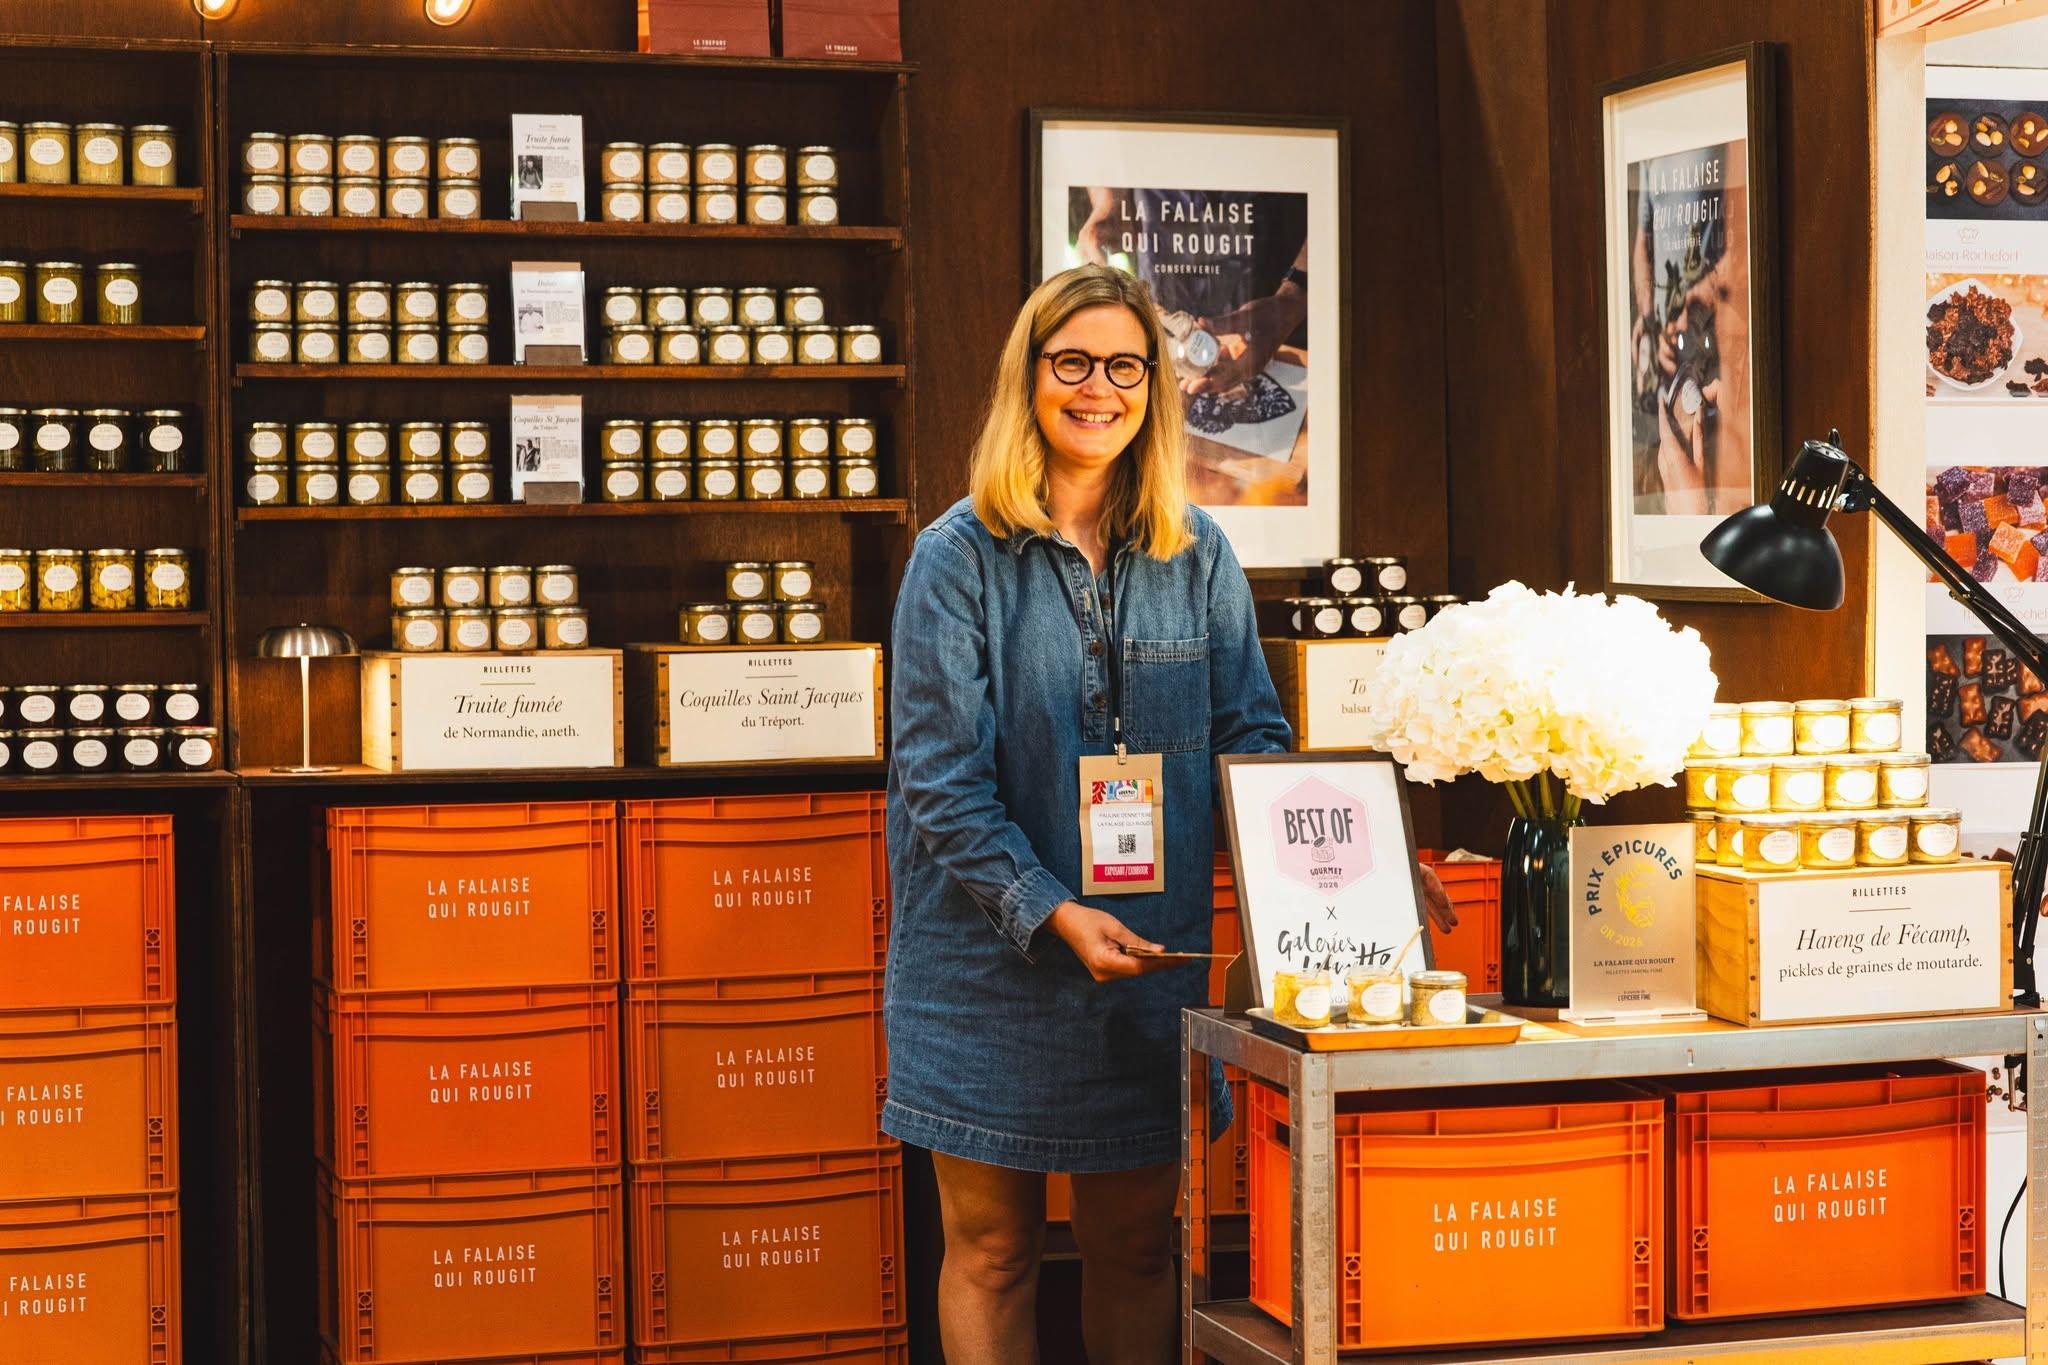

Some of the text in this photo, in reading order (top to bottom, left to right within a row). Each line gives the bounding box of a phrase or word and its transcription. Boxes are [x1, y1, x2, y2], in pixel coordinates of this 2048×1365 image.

[1653, 159, 1720, 196] LA FALAISE
[1121, 200, 1254, 224] LA FALAISE
[1652, 196, 1719, 231] QUI ROUGIT
[1121, 231, 1254, 256] QUI ROUGIT
[1154, 263, 1221, 275] CONSERVERIE
[483, 665, 532, 674] RILLETTES
[748, 658, 793, 667] RILLETTES
[454, 694, 563, 719] Truite fumée
[680, 687, 864, 713] Coquilles Saint Jacques
[443, 724, 580, 739] de Normandie, aneth.
[741, 714, 805, 730] du Tréport.
[1283, 808, 1354, 846] BEST OF
[713, 866, 812, 886] LA FALAISE
[1310, 867, 1343, 876] GOURMET
[1586, 839, 1683, 916] PRIX ÉPICURES
[427, 876, 530, 896] LA FALAISE
[1852, 886, 1907, 897] RILLETTES
[3, 893, 80, 912] FALAISE
[428, 899, 530, 919] QUI ROUGIT
[714, 889, 812, 909] QUI ROUGIT
[13, 917, 80, 936] ROUGIT
[1600, 925, 1615, 940] OR
[1277, 921, 1357, 963] Galeries
[1796, 923, 1971, 954] Hareng de Fécamp,
[1604, 959, 1633, 967] FALAISE
[1634, 958, 1648, 966] QUI
[1648, 957, 1675, 965] ROUGIT
[1779, 953, 1983, 983] pickles de graines de moutarde.
[716, 1046, 815, 1066] LA FALAISE
[429, 1060, 532, 1081] LA FALAISE
[717, 1068, 815, 1089] QUI ROUGIT
[6, 1083, 83, 1102] FALAISE
[430, 1083, 532, 1104] QUI ROUGIT
[16, 1106, 84, 1125] ROUGIT
[1773, 1168, 1887, 1195] LA FALAISE
[1433, 1197, 1557, 1223] LA FALAISE
[1773, 1196, 1887, 1223] QUI ROUGIT
[722, 1225, 820, 1247] LA FALAISE
[1433, 1226, 1557, 1252] QUI ROUGIT
[433, 1244, 536, 1265] LA FALAISE
[723, 1247, 821, 1269] QUI ROUGIT
[9, 1272, 87, 1293] FALAISE
[434, 1267, 536, 1288] QUI ROUGIT
[19, 1296, 87, 1316] ROUGIT
